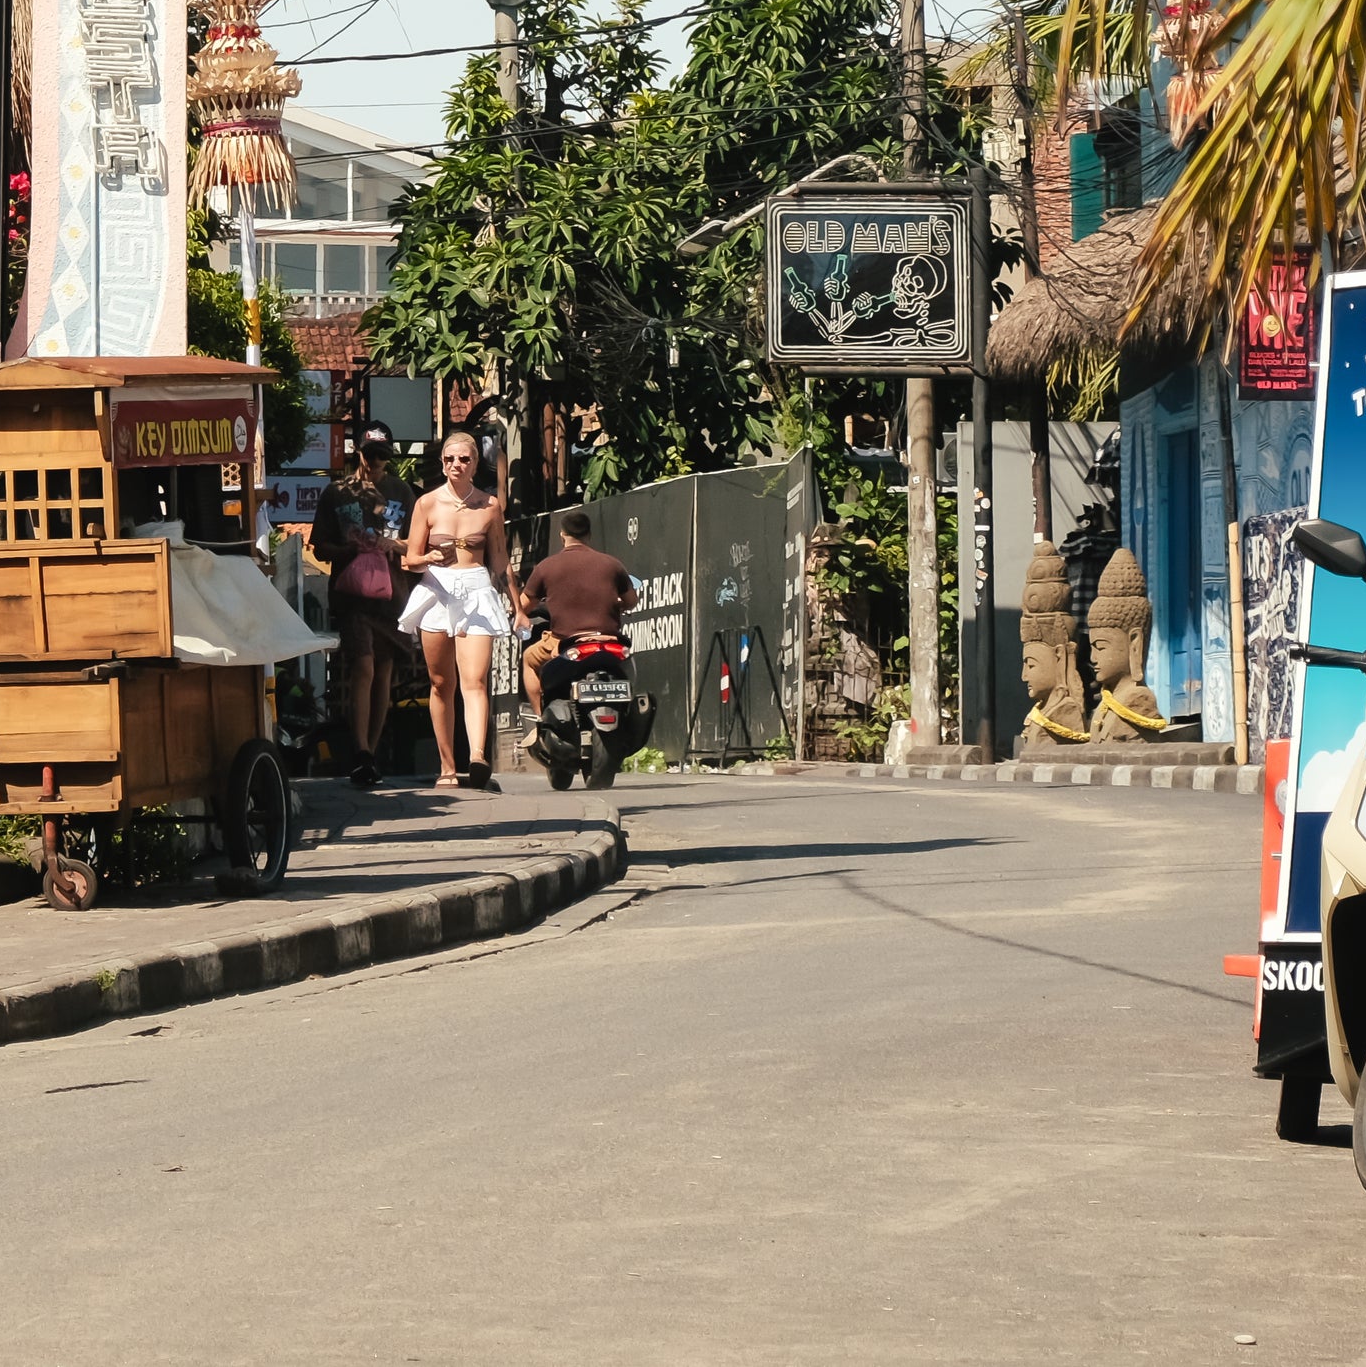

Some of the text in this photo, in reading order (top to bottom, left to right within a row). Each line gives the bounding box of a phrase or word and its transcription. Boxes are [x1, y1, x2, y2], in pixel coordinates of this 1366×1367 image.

[783, 215, 952, 256] OLD MAN'S
[136, 418, 233, 458] KEY DIMSUM
[296, 487, 322, 500] TIPSY
[653, 572, 684, 609] BLACK
[656, 613, 683, 650] SOON
